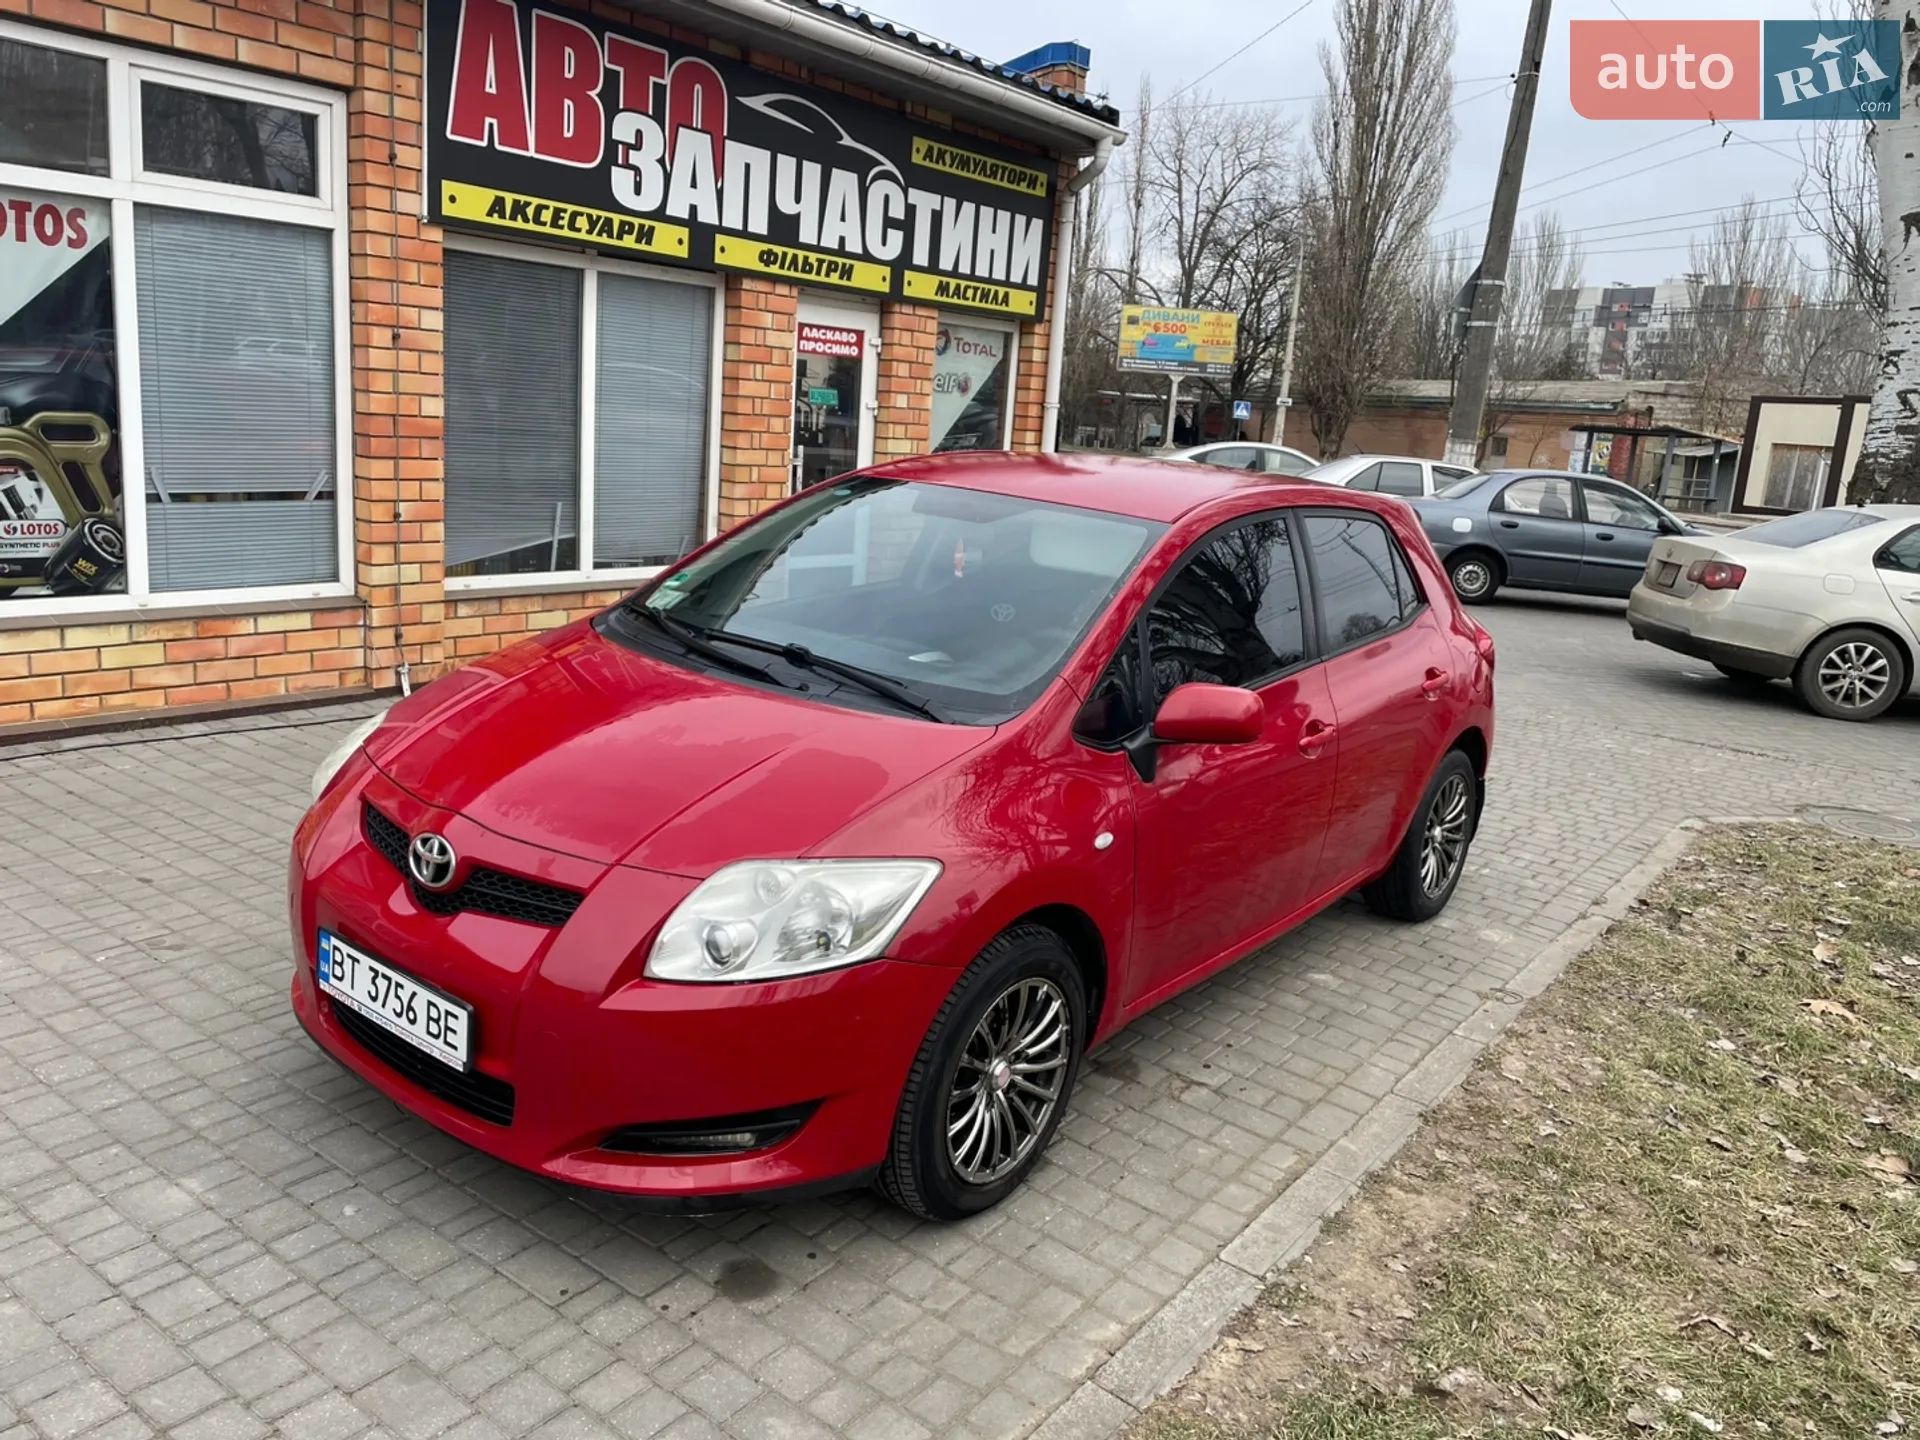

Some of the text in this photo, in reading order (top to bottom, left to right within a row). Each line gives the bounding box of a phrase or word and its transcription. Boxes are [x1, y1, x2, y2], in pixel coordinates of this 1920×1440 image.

[446, 0, 728, 189] АВТО
[921, 143, 1040, 191] АКУМУЛЯТОРИ
[610, 110, 1044, 287] ЗАПЧАСТИНИ
[0, 199, 88, 249] TOS
[486, 194, 655, 247] АКСЕСУАРИ
[757, 247, 855, 282] ФІЛЬТРИ
[934, 279, 1011, 309] МАСТИЛА
[1142, 310, 1200, 324] ДИВАНИ
[799, 339, 859, 356] ПРОСИМО
[802, 326, 857, 343] ЛАСКАВО
[953, 337, 997, 357] TOTAL
[934, 372, 958, 393] elf
[20, 522, 60, 536] LOTOS
[320, 961, 328, 972] UA
[332, 944, 360, 991] BT
[367, 965, 418, 1026] 3756
[426, 999, 460, 1052] BE
